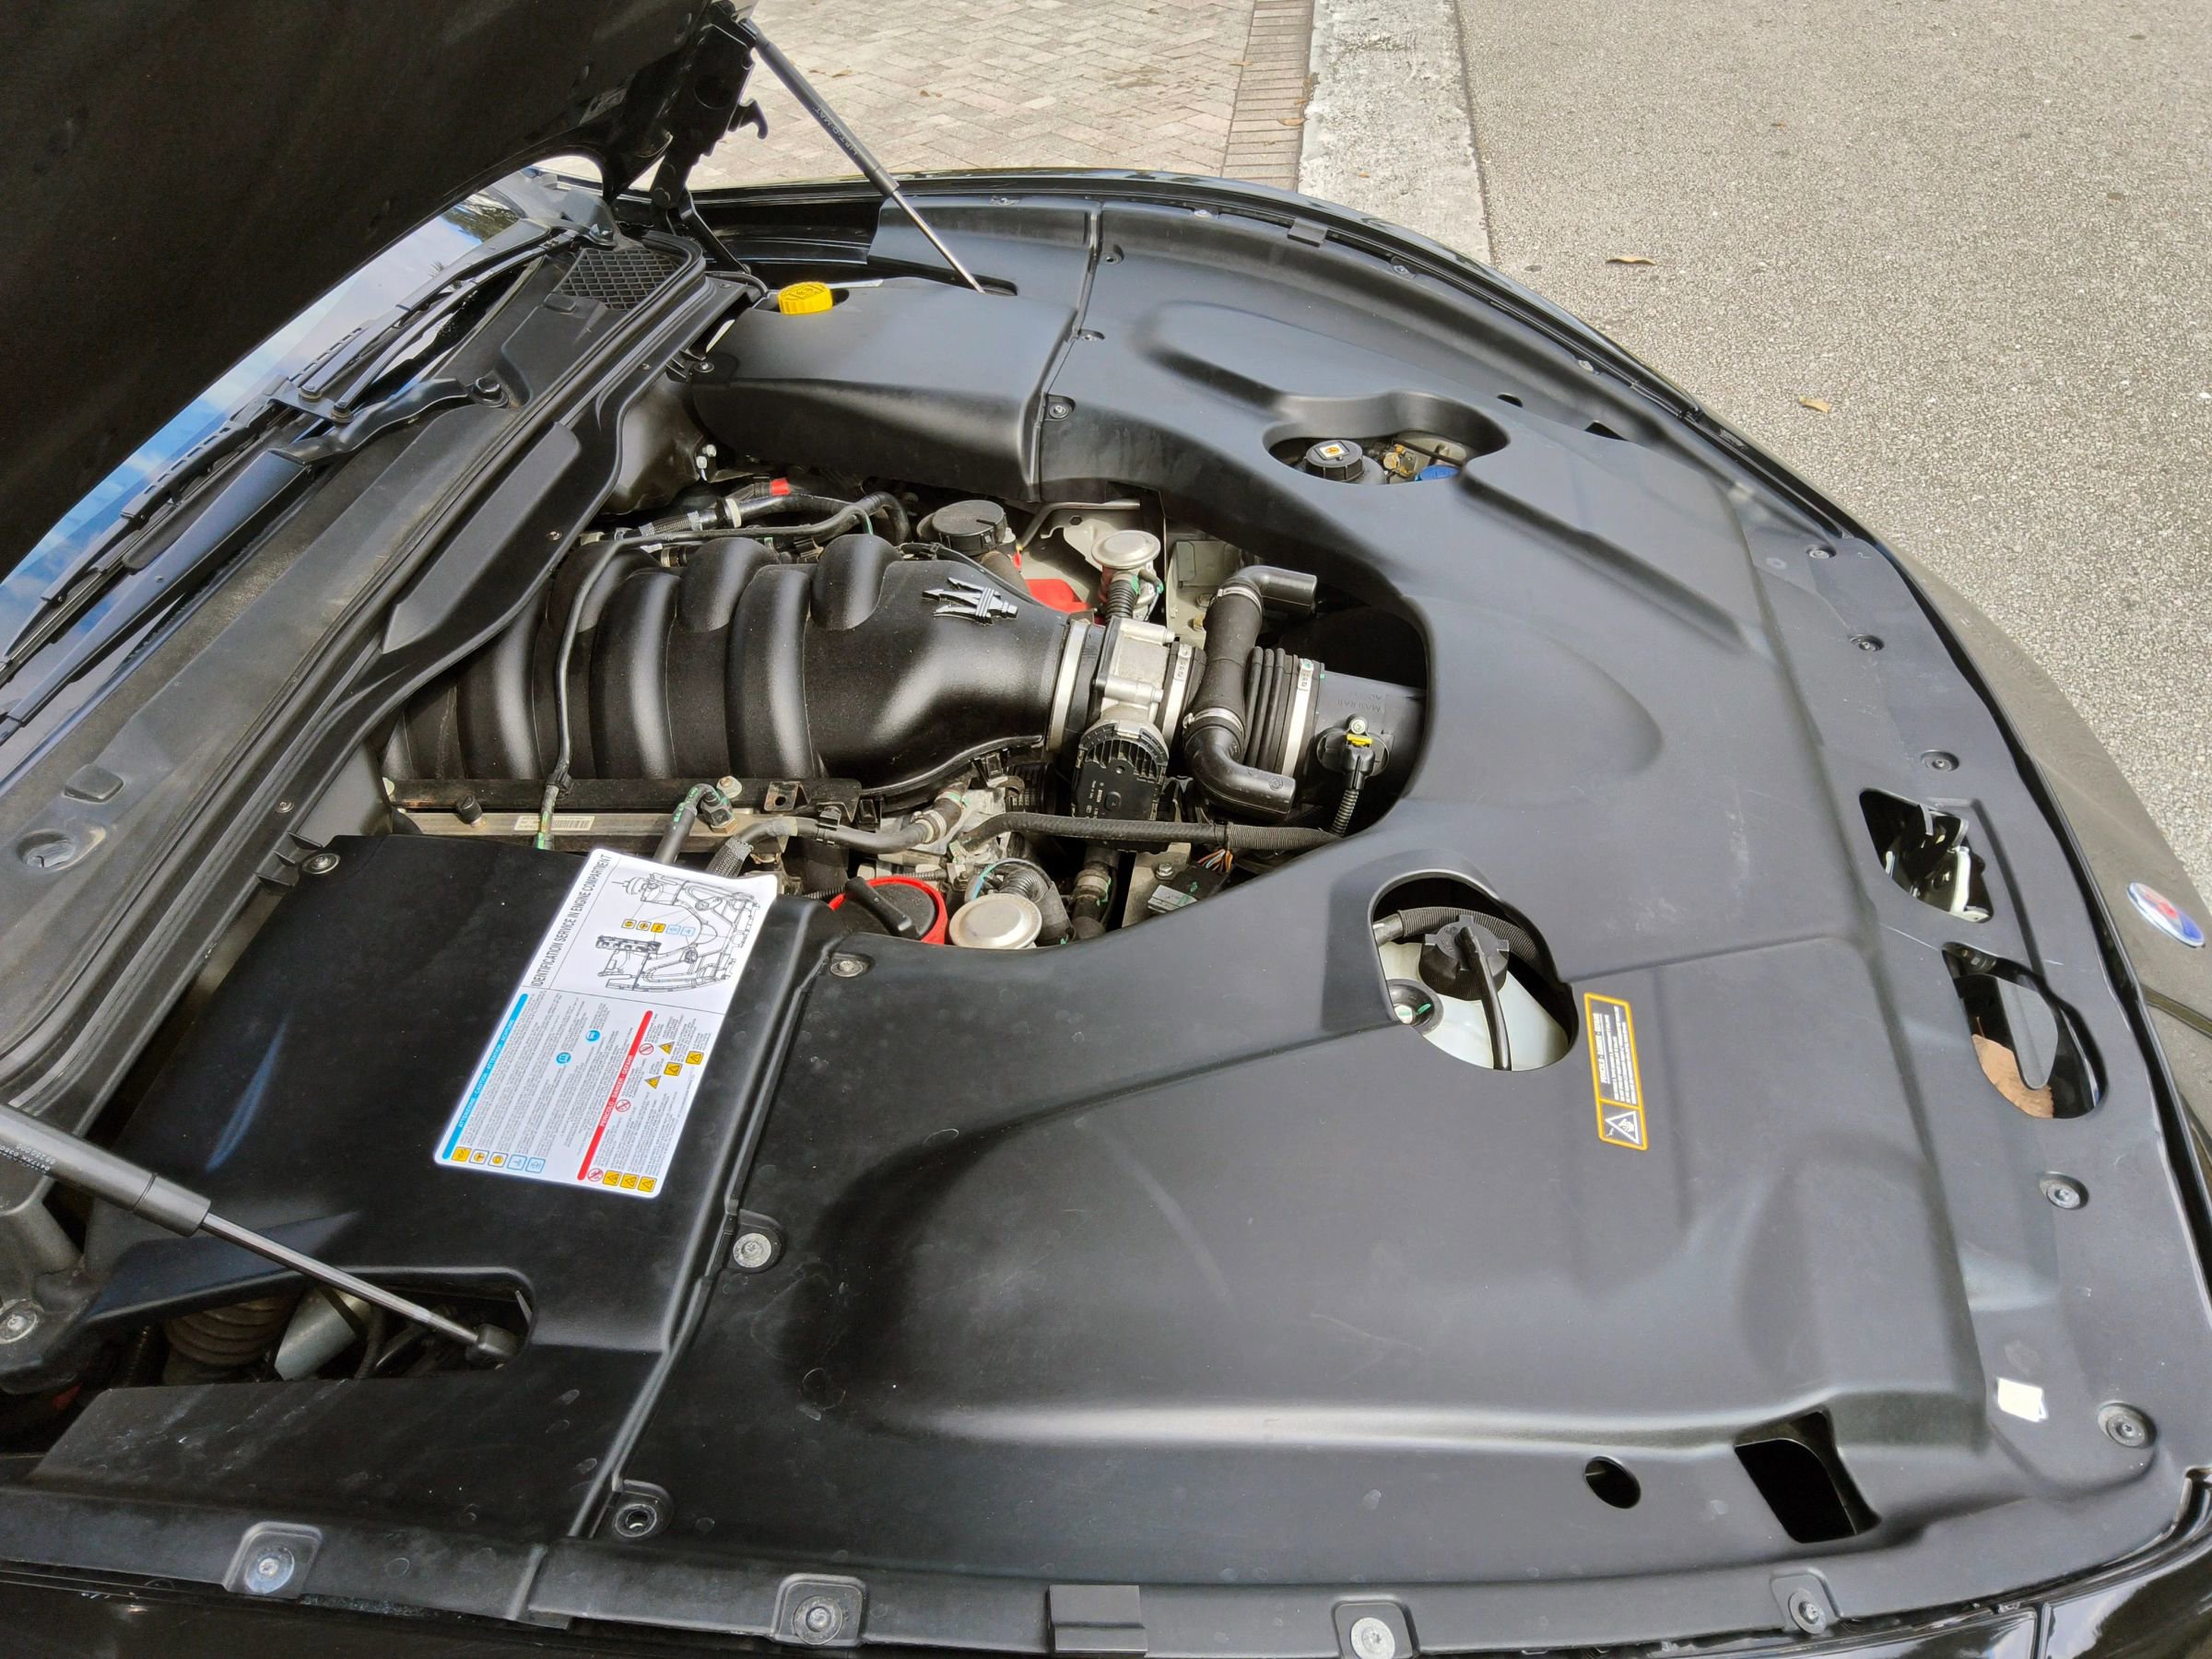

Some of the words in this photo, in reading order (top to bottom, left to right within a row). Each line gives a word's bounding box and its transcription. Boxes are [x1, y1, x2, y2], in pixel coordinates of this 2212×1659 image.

[530, 942, 564, 987] IDENTIFICATION
[554, 918, 577, 943] SERVICE
[571, 891, 591, 912] ENGINE
[582, 853, 612, 891] COMPARTMENT
[611, 1077, 625, 1098] DANGER
